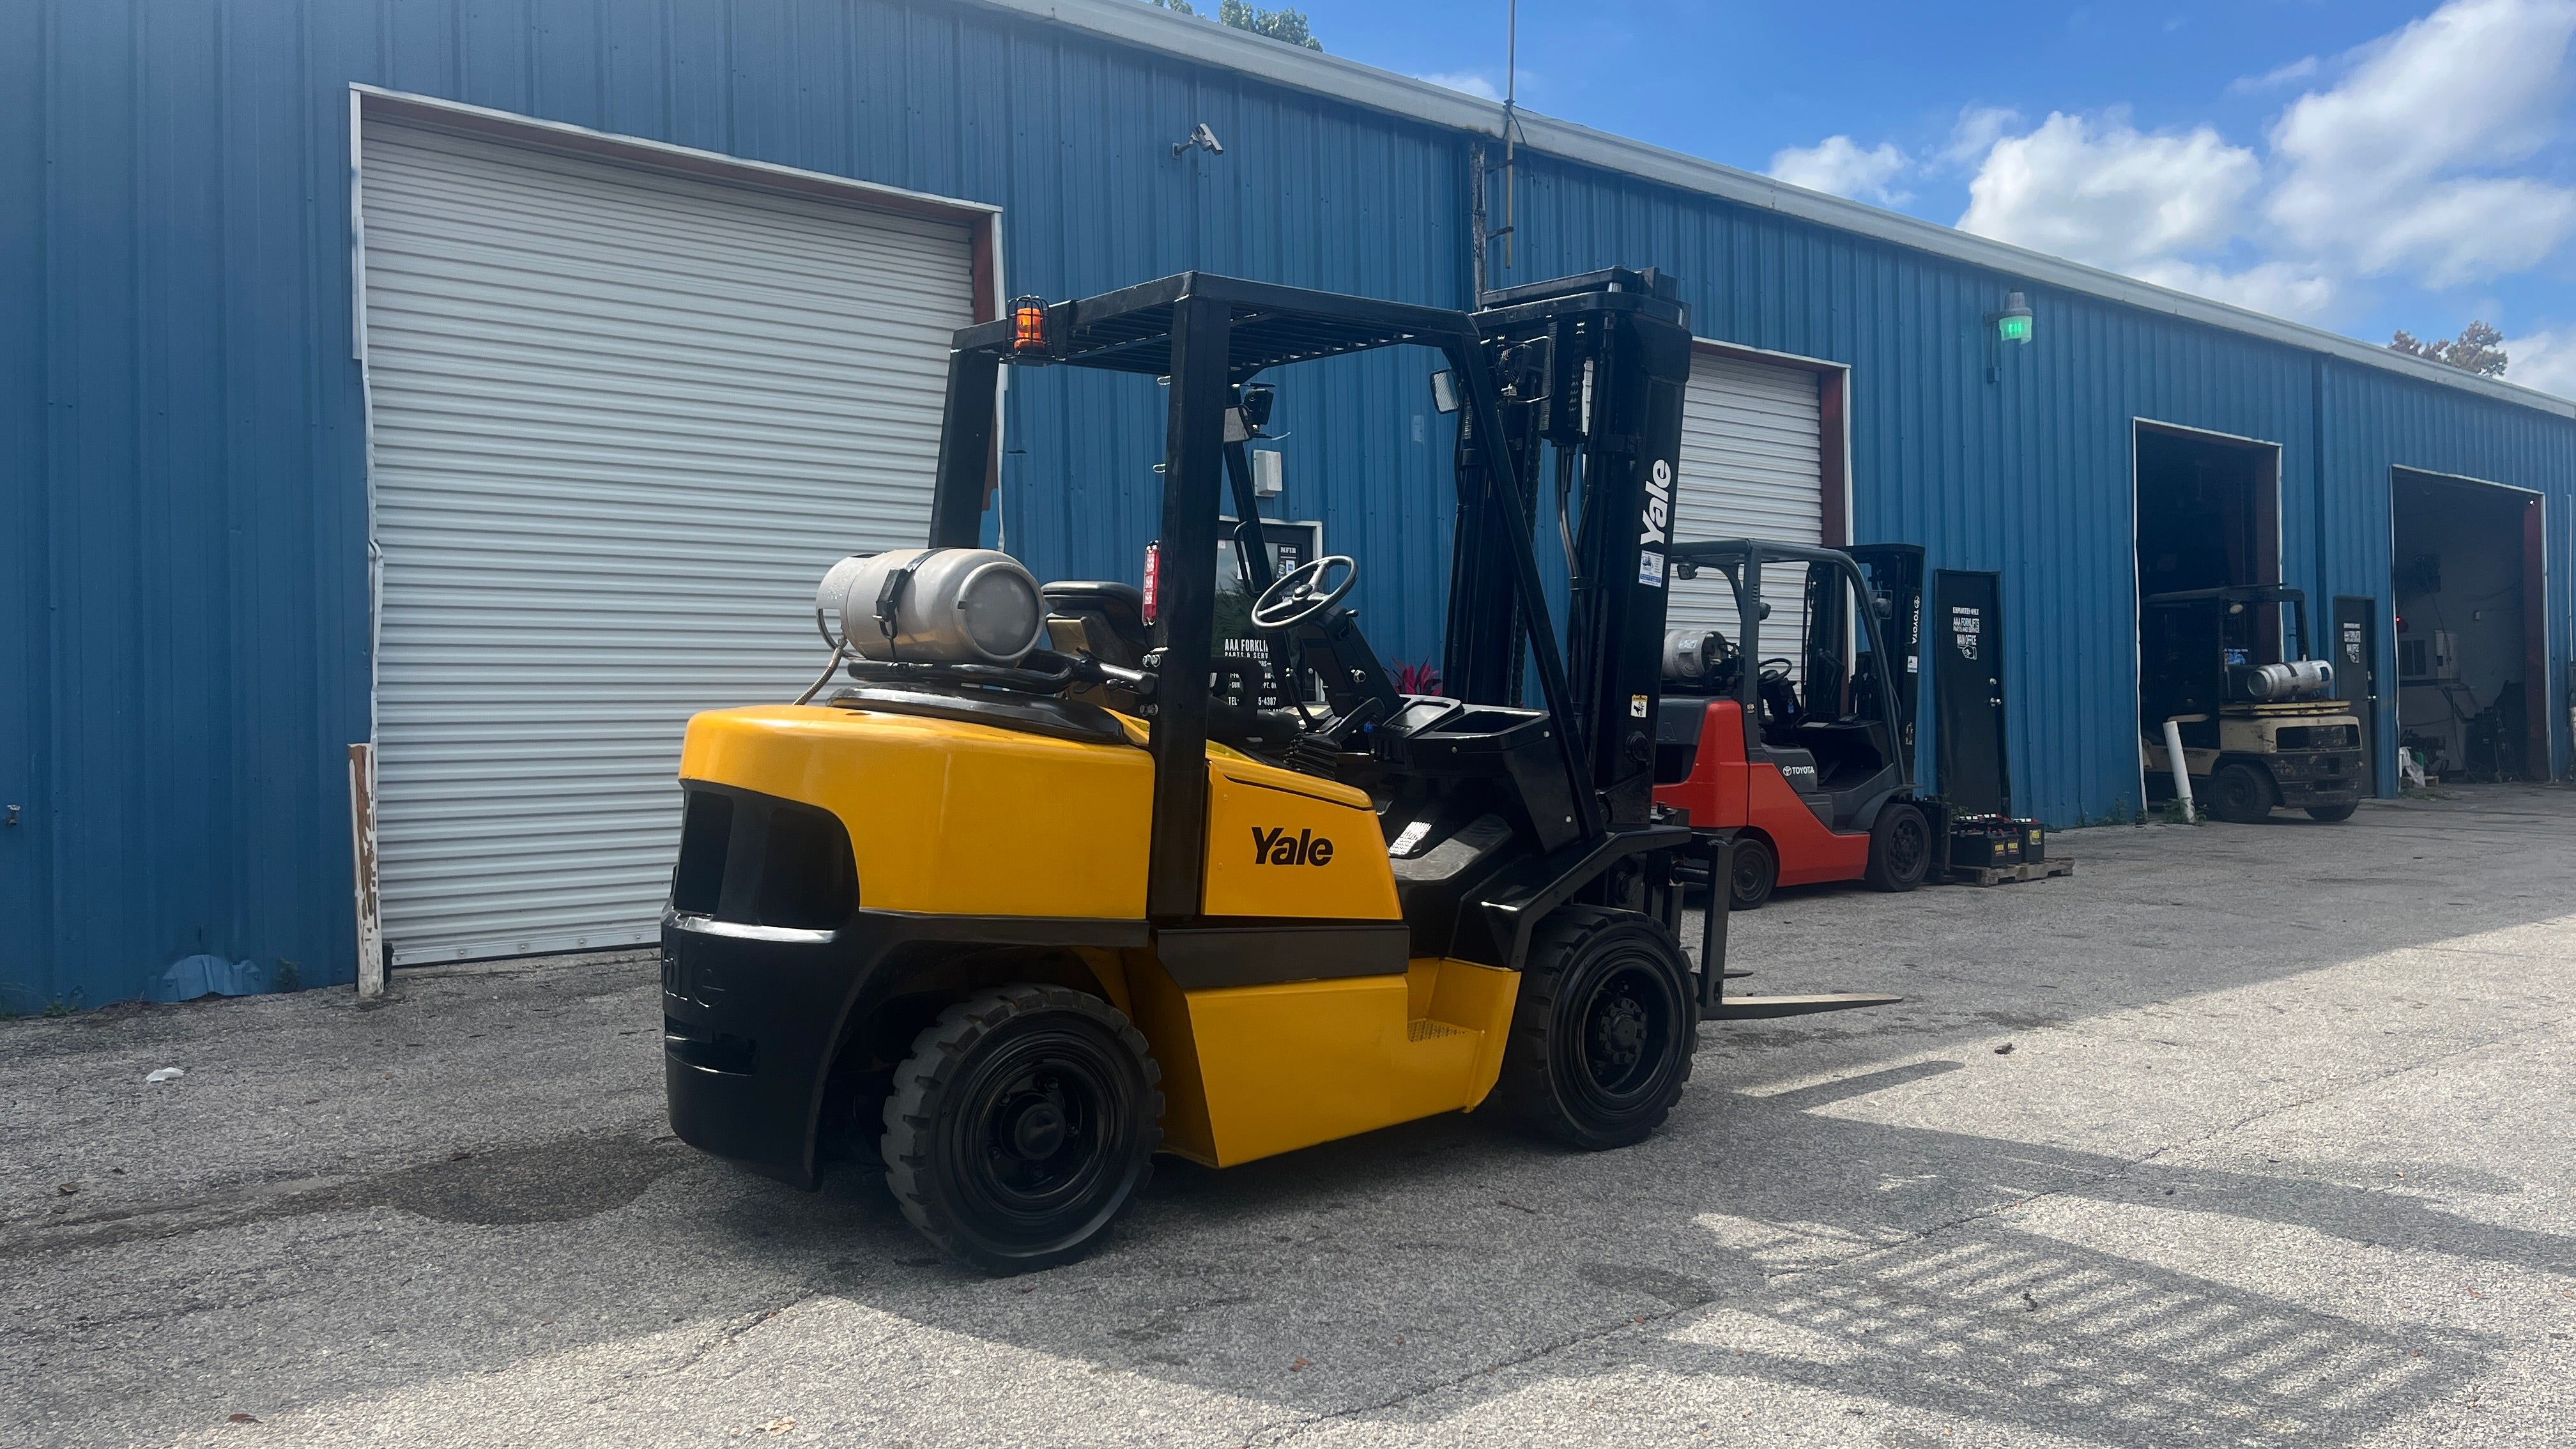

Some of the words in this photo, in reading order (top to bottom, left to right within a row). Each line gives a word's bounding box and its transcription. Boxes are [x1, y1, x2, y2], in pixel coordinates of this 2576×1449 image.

[1640, 459, 1671, 544] Yale
[1225, 639, 1239, 651] AAA
[1258, 696, 1276, 705] 5-4387
[1792, 766, 1814, 774] TOYOTA
[1251, 826, 1334, 867] Yale
